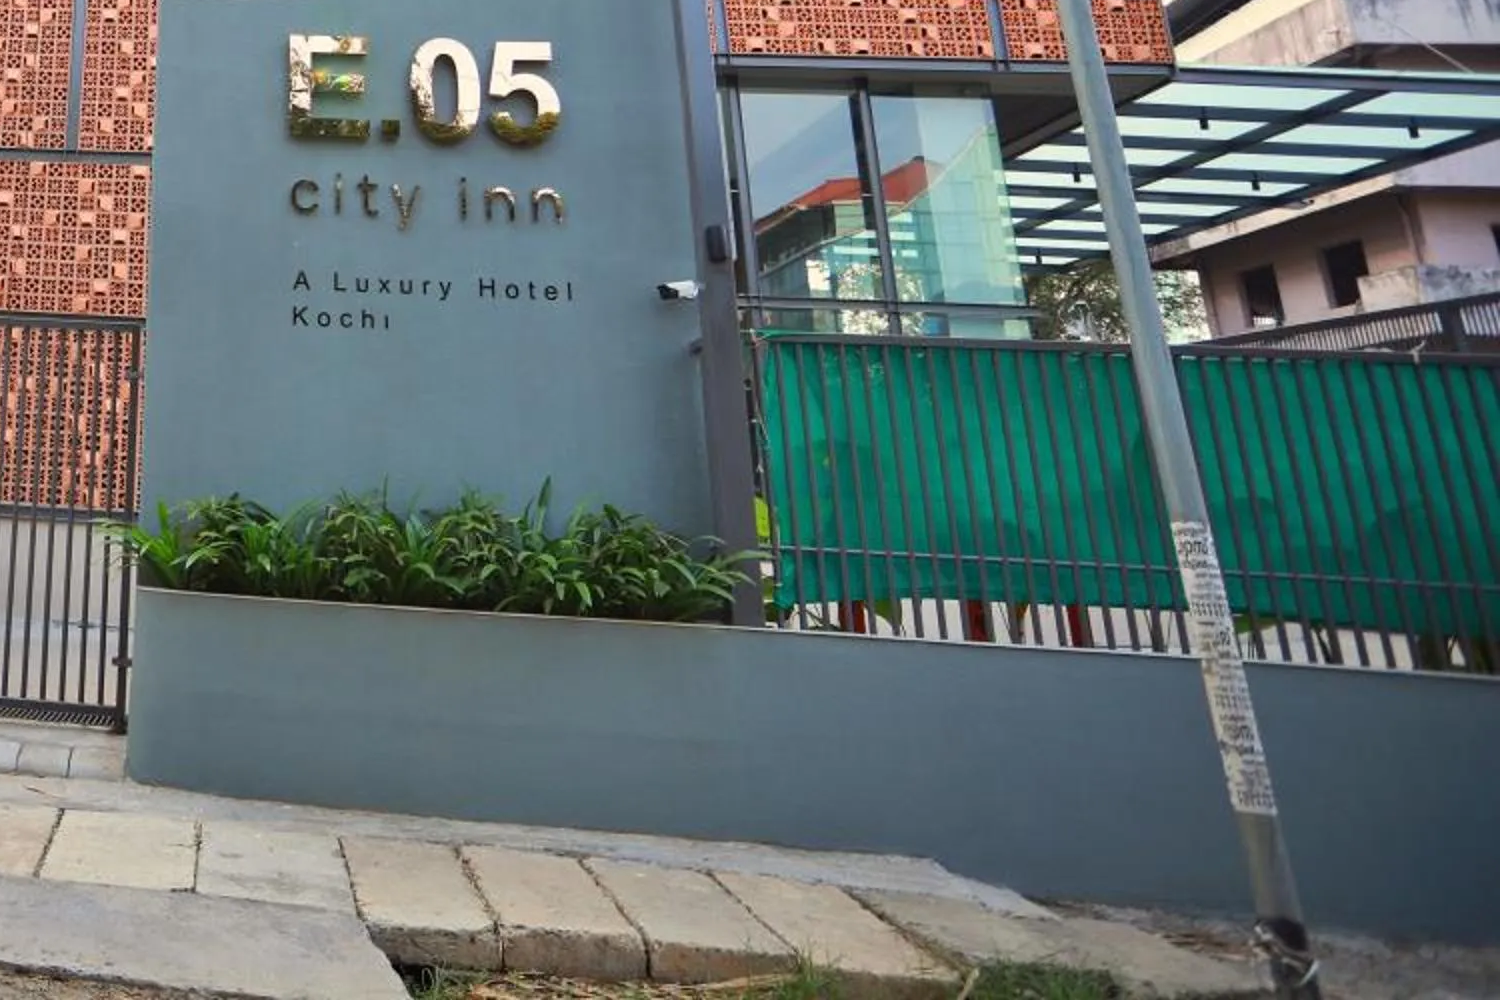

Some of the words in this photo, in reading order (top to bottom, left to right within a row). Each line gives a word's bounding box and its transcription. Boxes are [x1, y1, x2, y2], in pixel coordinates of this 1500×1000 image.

[289, 34, 561, 146] E.05
[291, 173, 420, 231] city
[459, 177, 564, 224] inn
[293, 271, 311, 291] A
[333, 271, 452, 301] Luxury
[478, 278, 573, 301] Hotel
[292, 306, 390, 330] Kochi
